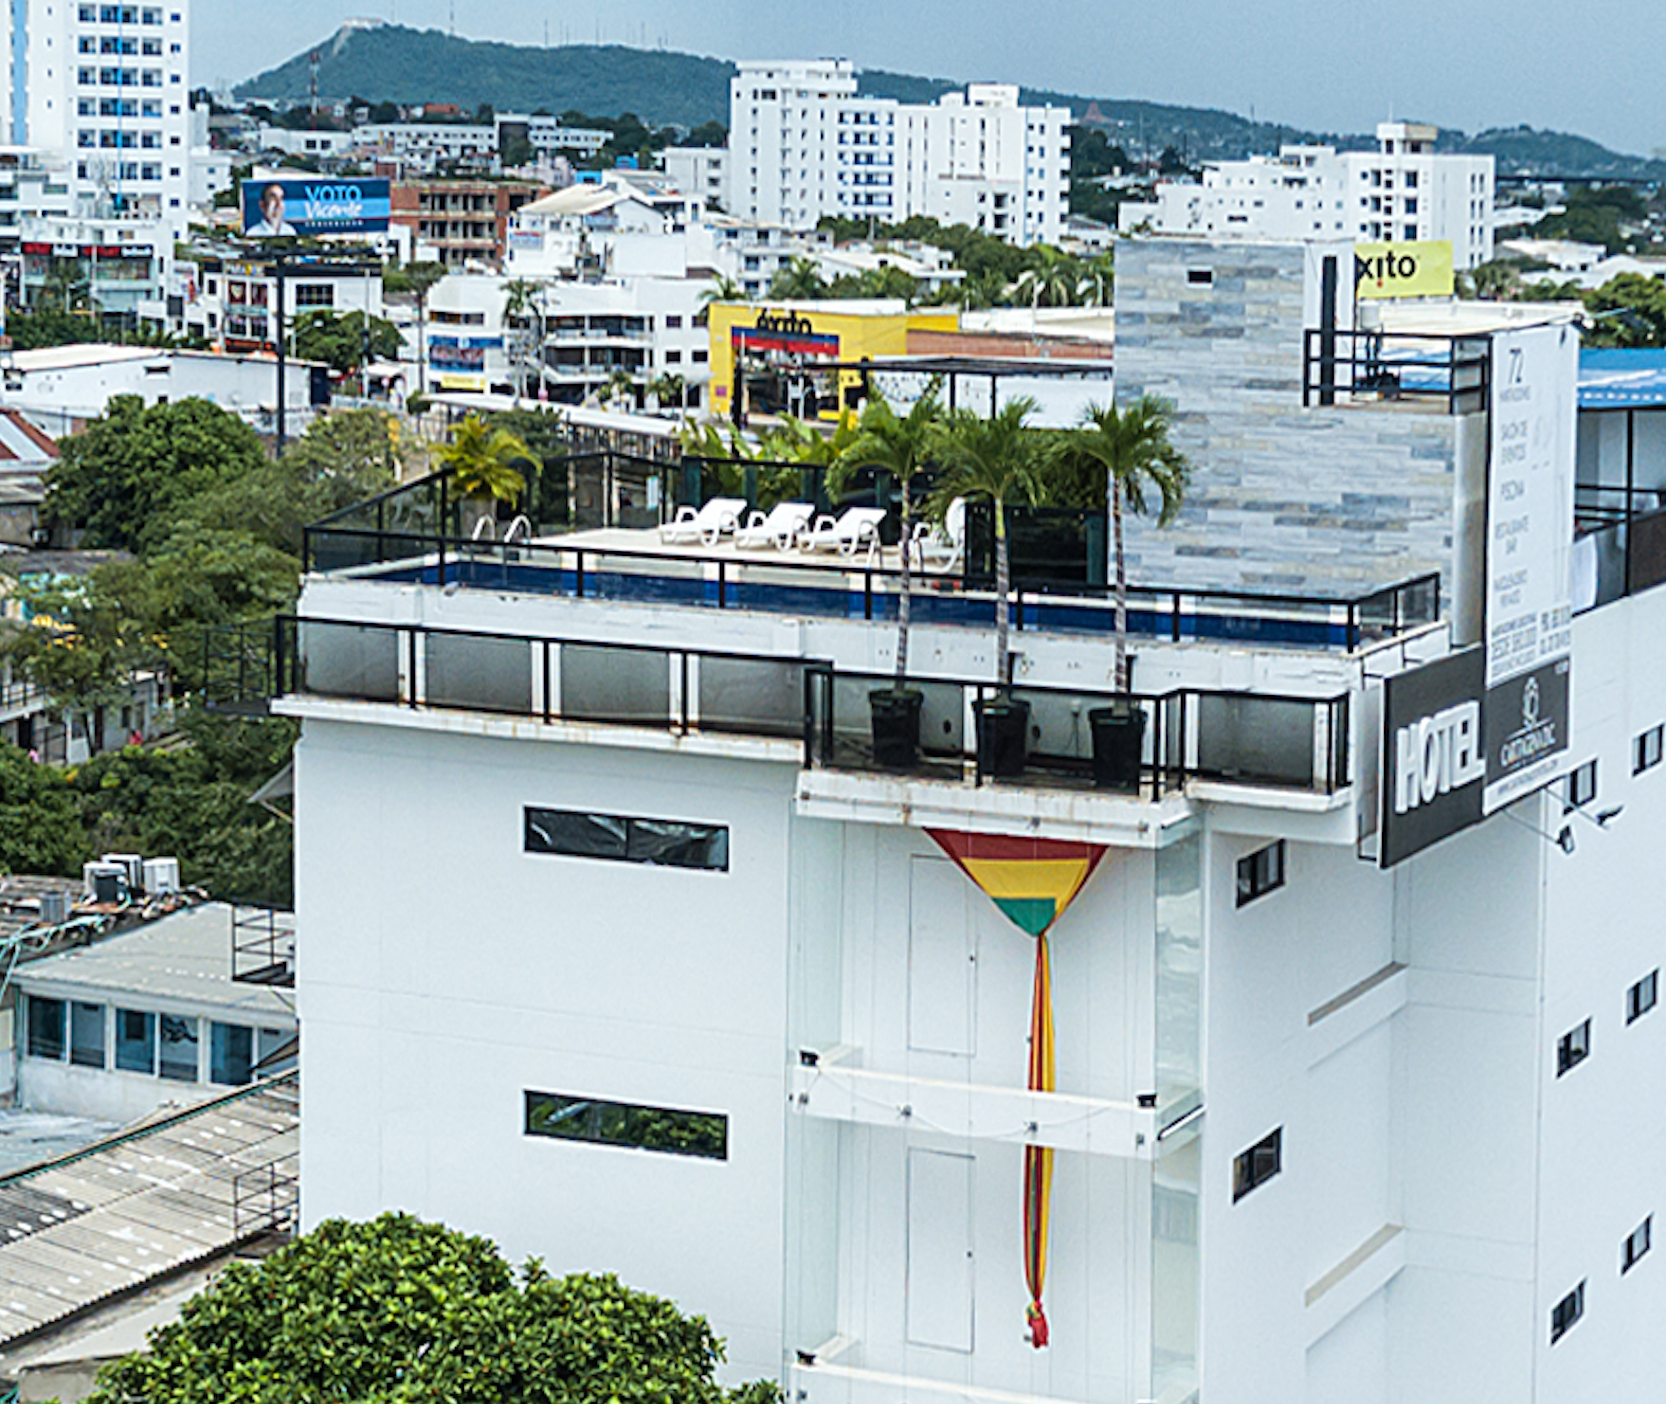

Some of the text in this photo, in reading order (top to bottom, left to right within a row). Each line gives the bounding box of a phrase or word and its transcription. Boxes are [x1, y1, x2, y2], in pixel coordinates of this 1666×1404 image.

[305, 184, 362, 200] VOTO
[304, 200, 362, 219] Vicente
[1395, 700, 1485, 814] HOTEL
